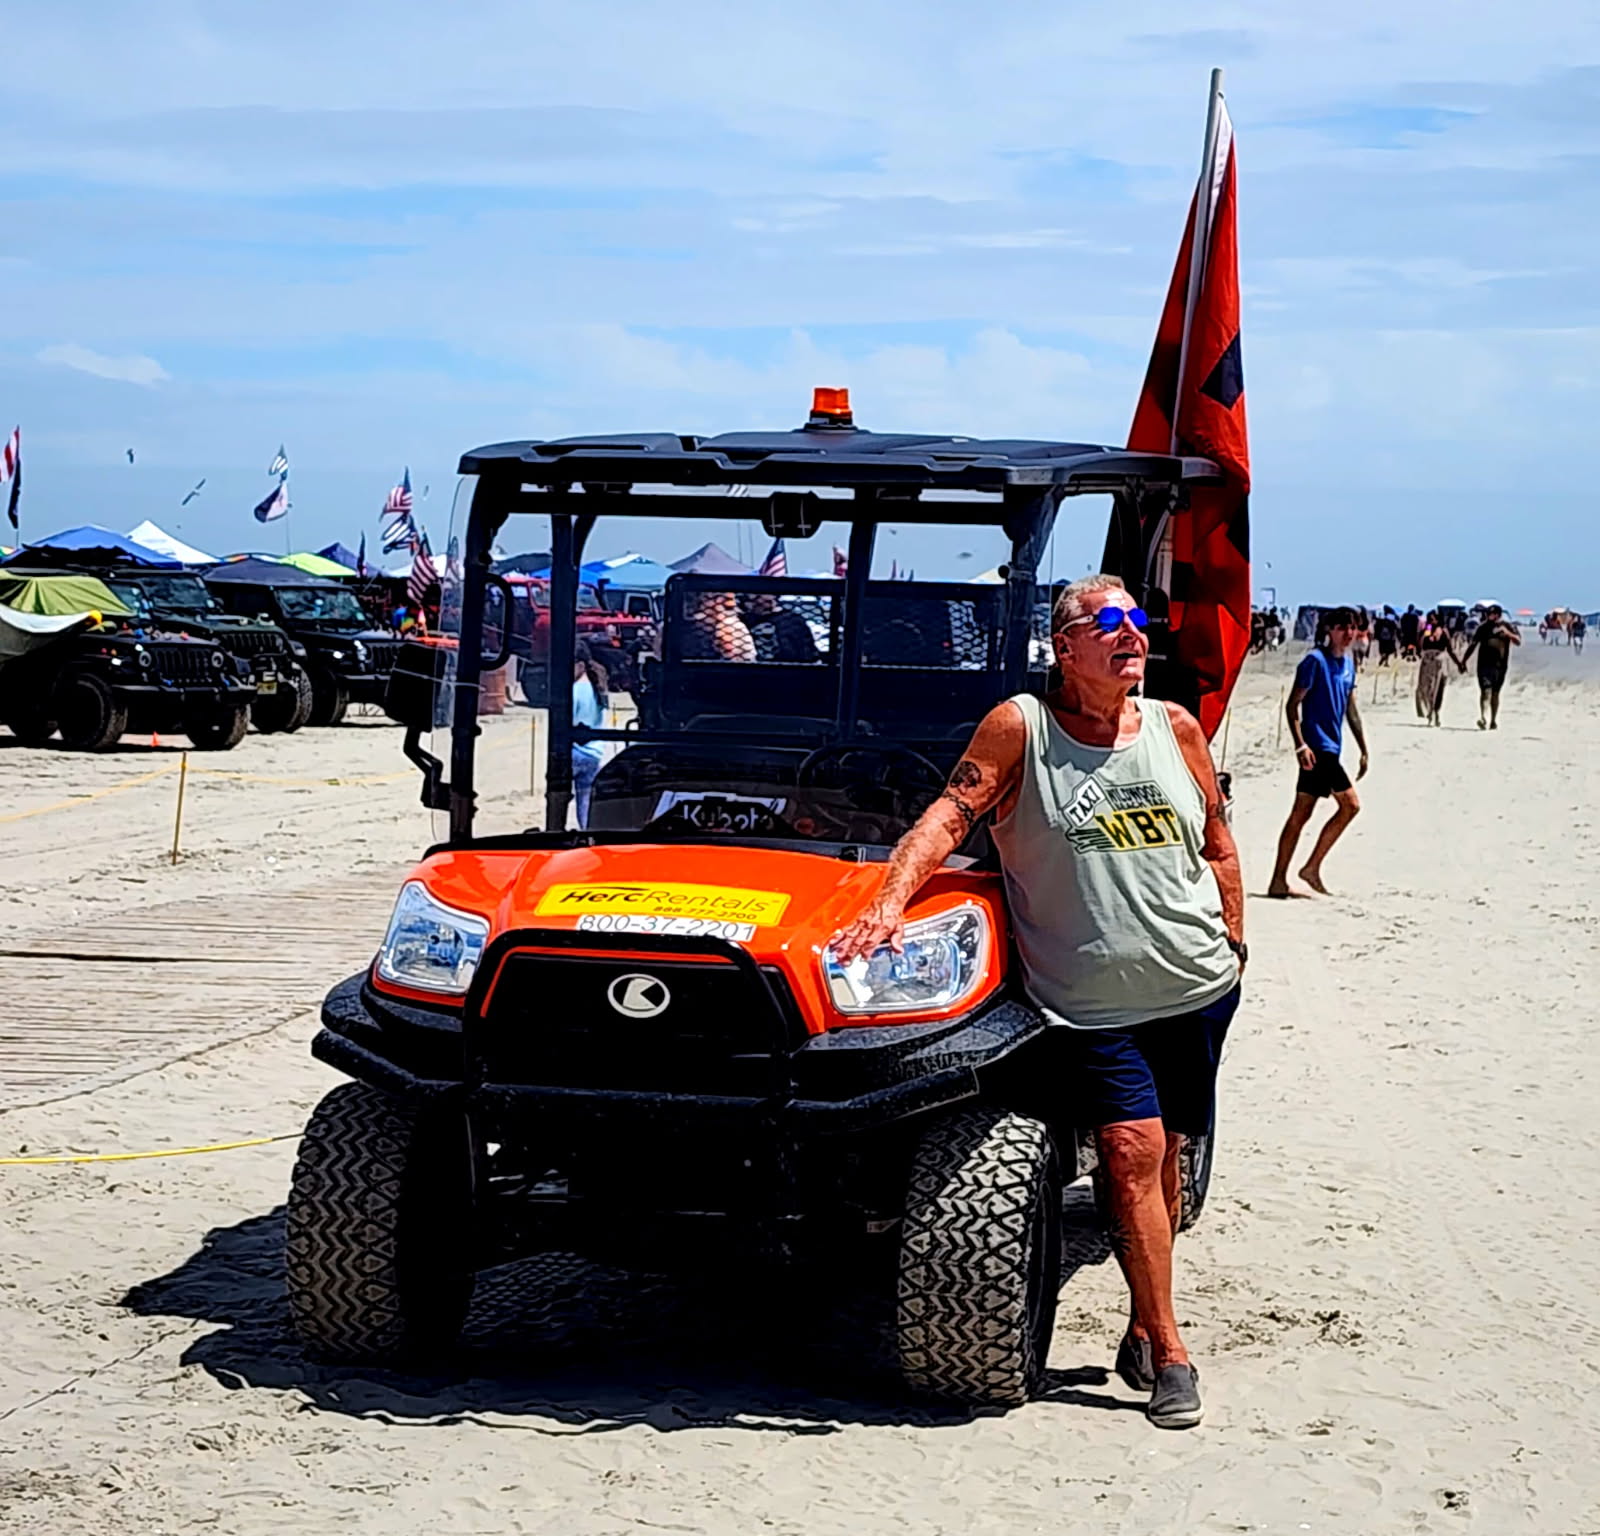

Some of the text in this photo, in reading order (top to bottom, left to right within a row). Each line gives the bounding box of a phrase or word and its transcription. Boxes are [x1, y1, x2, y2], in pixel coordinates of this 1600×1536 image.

[1069, 784, 1101, 823] TAXI
[1094, 808, 1181, 848] WBT
[579, 914, 754, 941] 800-37-2201
